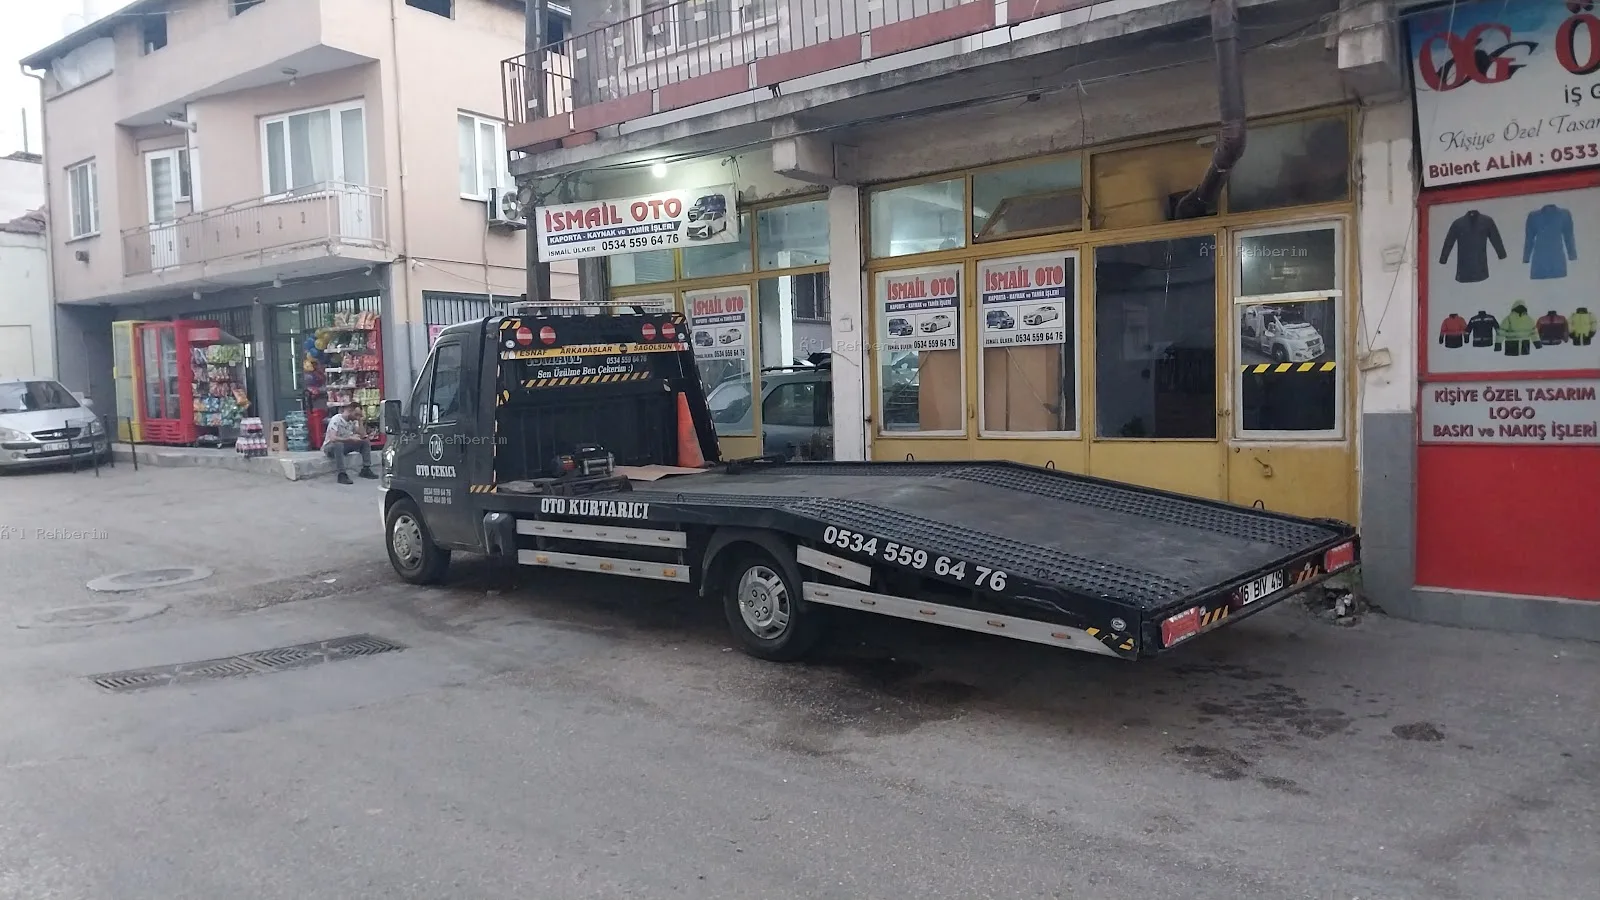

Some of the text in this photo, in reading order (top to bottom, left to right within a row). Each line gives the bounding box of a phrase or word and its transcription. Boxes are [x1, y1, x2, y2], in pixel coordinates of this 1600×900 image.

[1439, 130, 1495, 151] Kişiye
[1503, 118, 1543, 142] Özel
[1429, 160, 1480, 179] Bülent
[1486, 150, 1532, 171] ALİM
[1550, 143, 1599, 162] 0533
[545, 197, 682, 233] İSMAİL OTO
[550, 234, 582, 244] KAPORTA
[587, 229, 616, 239] KAYNAK
[627, 224, 649, 234] TAMİR
[650, 221, 674, 232] İŞLERİ
[601, 232, 679, 251] 0534 559 64 76
[985, 265, 1064, 292] İSMAİL OTO
[887, 276, 955, 301] İSMAİL OTO
[726, 296, 744, 312] OTO
[914, 338, 955, 348] 0534 559 64 76
[1015, 331, 1063, 343] 0534 559 64 76
[519, 350, 548, 358] ESNAF
[560, 346, 613, 355] ARKADAŞLAR
[606, 355, 648, 365] 0534 559 64 76
[537, 369, 552, 379] Sen
[553, 366, 581, 378] Üzülme
[582, 365, 597, 375] Ben
[598, 364, 627, 376] Çekerim
[1434, 386, 1596, 405] KİŞİYE ÖZEL TASARIM
[1489, 406, 1536, 420] LOGO
[1433, 421, 1597, 440] BASKI ve NAKIŞ İŞLERİ
[416, 464, 430, 476] OTO
[541, 498, 650, 520] OTO KURTARICI
[823, 526, 1008, 591] 0534 559 64 76
[1254, 577, 1268, 597] BIV
